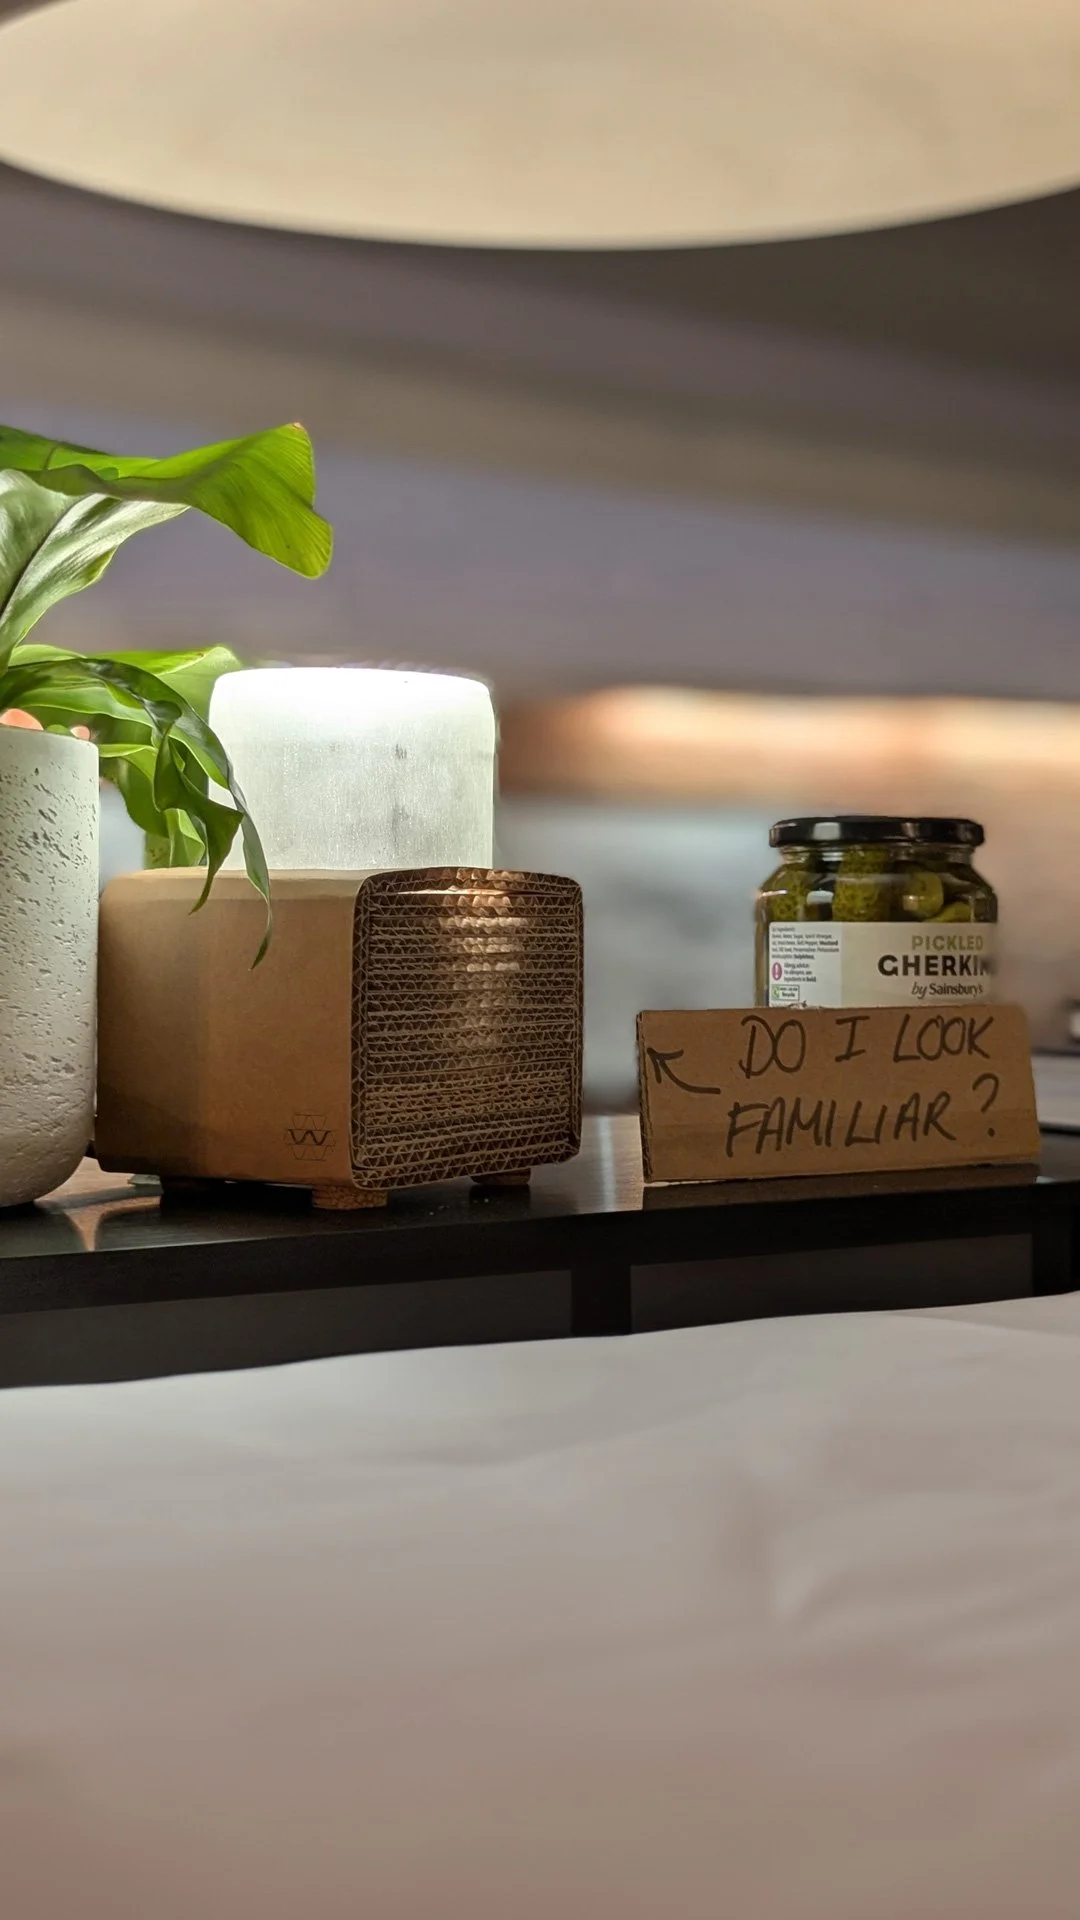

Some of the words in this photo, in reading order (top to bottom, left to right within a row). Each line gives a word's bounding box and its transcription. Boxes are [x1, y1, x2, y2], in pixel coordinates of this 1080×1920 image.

[911, 935, 984, 951] PICKLED
[911, 981, 928, 999] by
[738, 1014, 807, 1079] DO
[834, 1015, 871, 1062] I
[892, 1013, 994, 1063] LOOK
